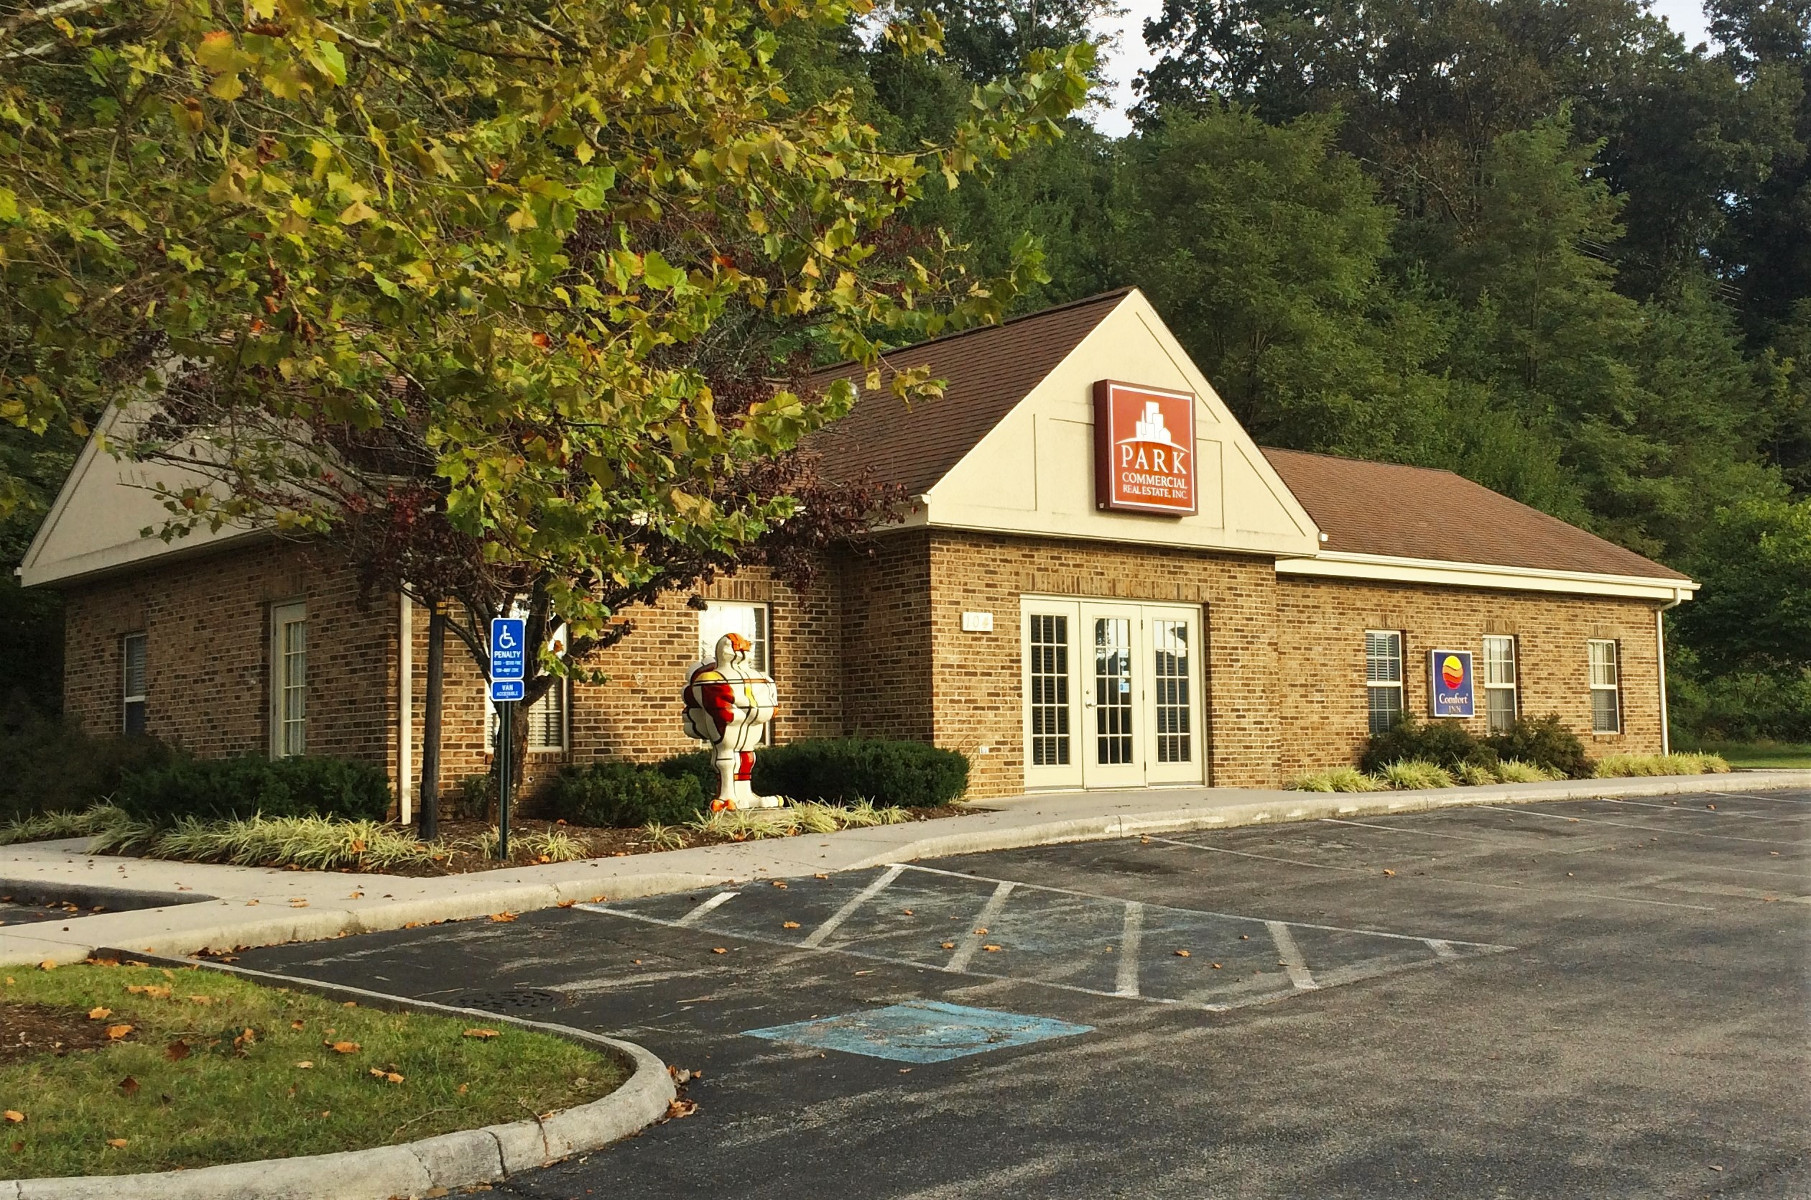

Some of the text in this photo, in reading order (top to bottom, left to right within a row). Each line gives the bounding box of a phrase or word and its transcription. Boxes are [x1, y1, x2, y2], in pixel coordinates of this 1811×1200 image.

[1121, 445, 1187, 474] PARK
[1122, 472, 1188, 489] COMMERCIAL
[1123, 484, 1141, 494] REAL
[1439, 693, 1468, 704] Comfort
